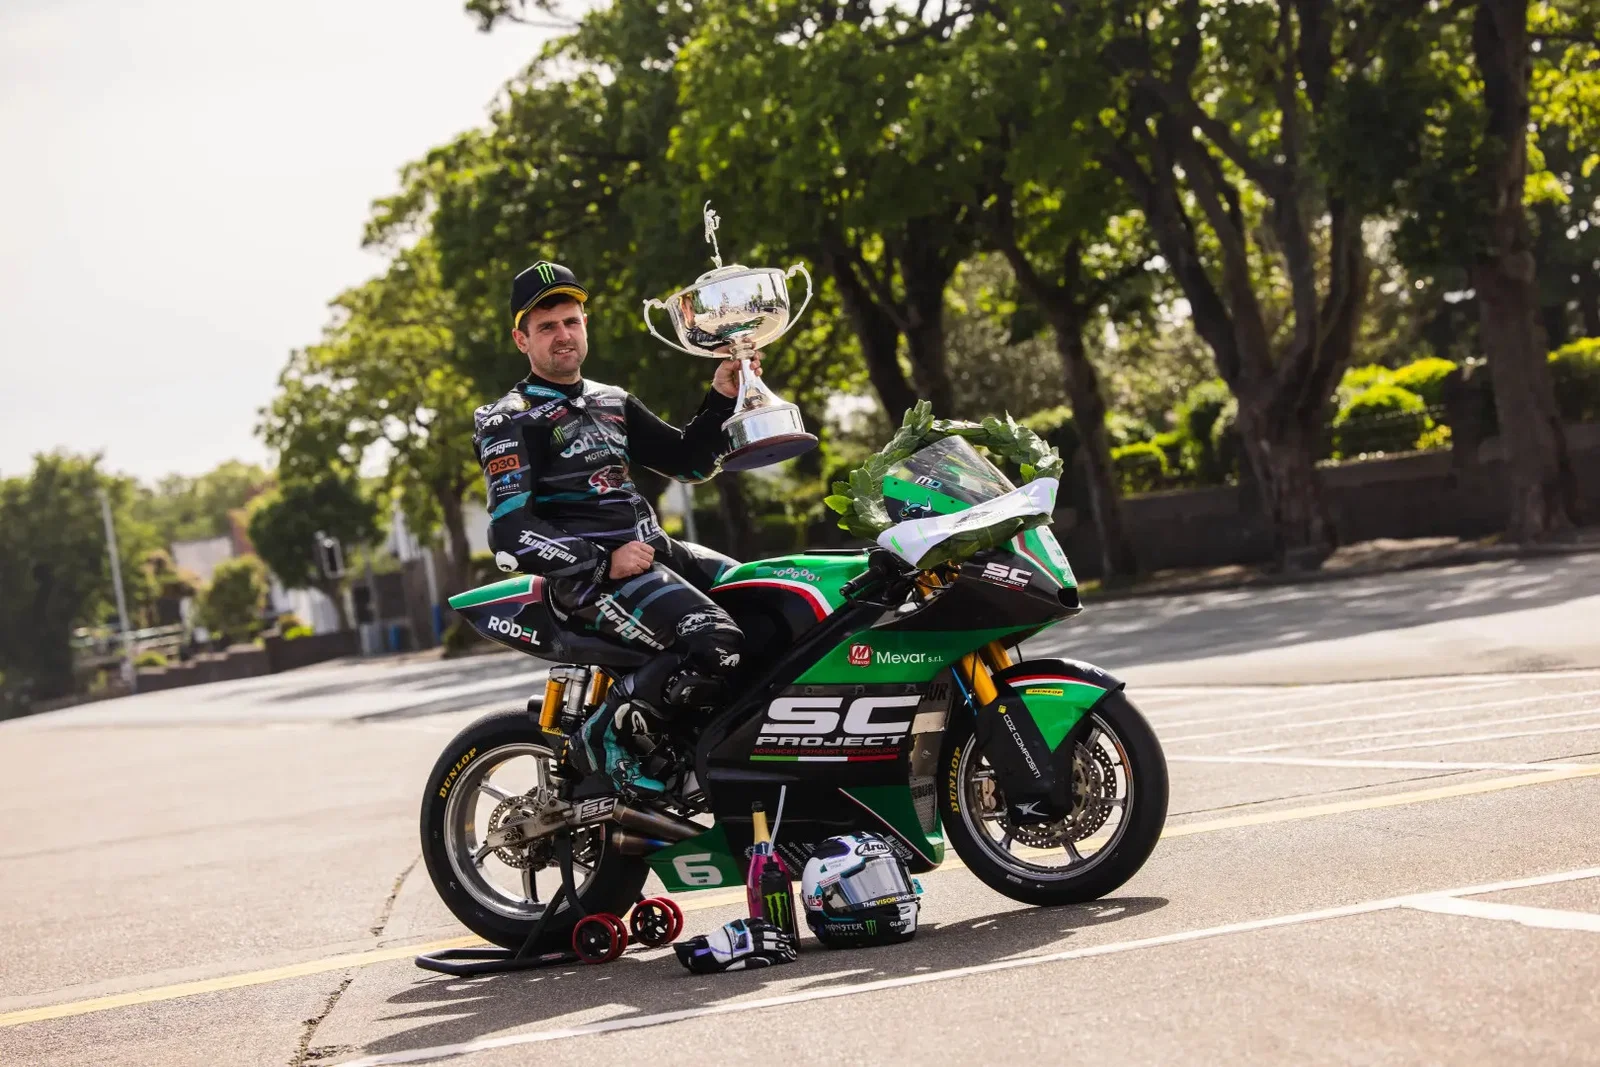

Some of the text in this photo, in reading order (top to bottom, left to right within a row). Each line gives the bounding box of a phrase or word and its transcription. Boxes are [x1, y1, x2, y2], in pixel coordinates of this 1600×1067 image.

[983, 562, 1033, 584] SC
[487, 615, 541, 646] RODEL
[876, 651, 926, 664] Mevar
[760, 695, 921, 735] SC
[755, 735, 906, 747] PROJECT
[1013, 731, 1041, 779] COMPOSITI
[439, 747, 477, 798] DUNLOP
[948, 747, 962, 813] DUNLOP
[582, 798, 614, 815] SC
[863, 841, 889, 853] Arai
[673, 854, 722, 885] 6
